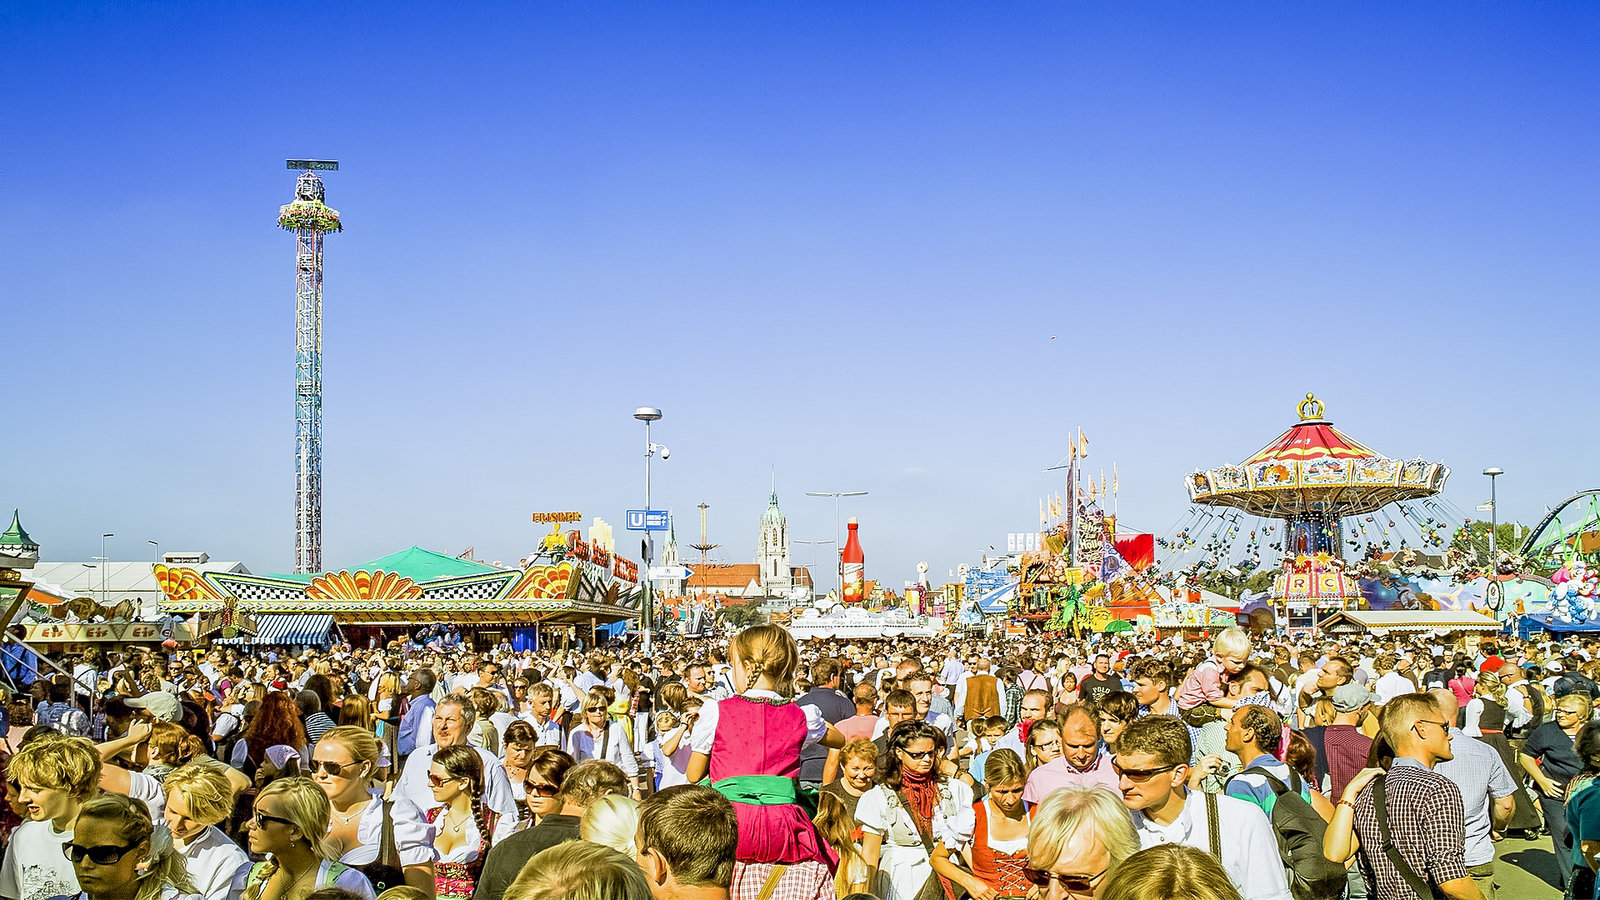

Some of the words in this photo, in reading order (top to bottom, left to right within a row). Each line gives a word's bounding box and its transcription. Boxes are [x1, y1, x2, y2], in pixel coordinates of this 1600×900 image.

[631, 513, 643, 526] U
[1294, 579, 1305, 587] R
[1324, 578, 1334, 587] C
[41, 627, 63, 638] Eis
[86, 627, 109, 638] Eis
[132, 626, 155, 638] Eis
[1092, 686, 1111, 694] POLO
